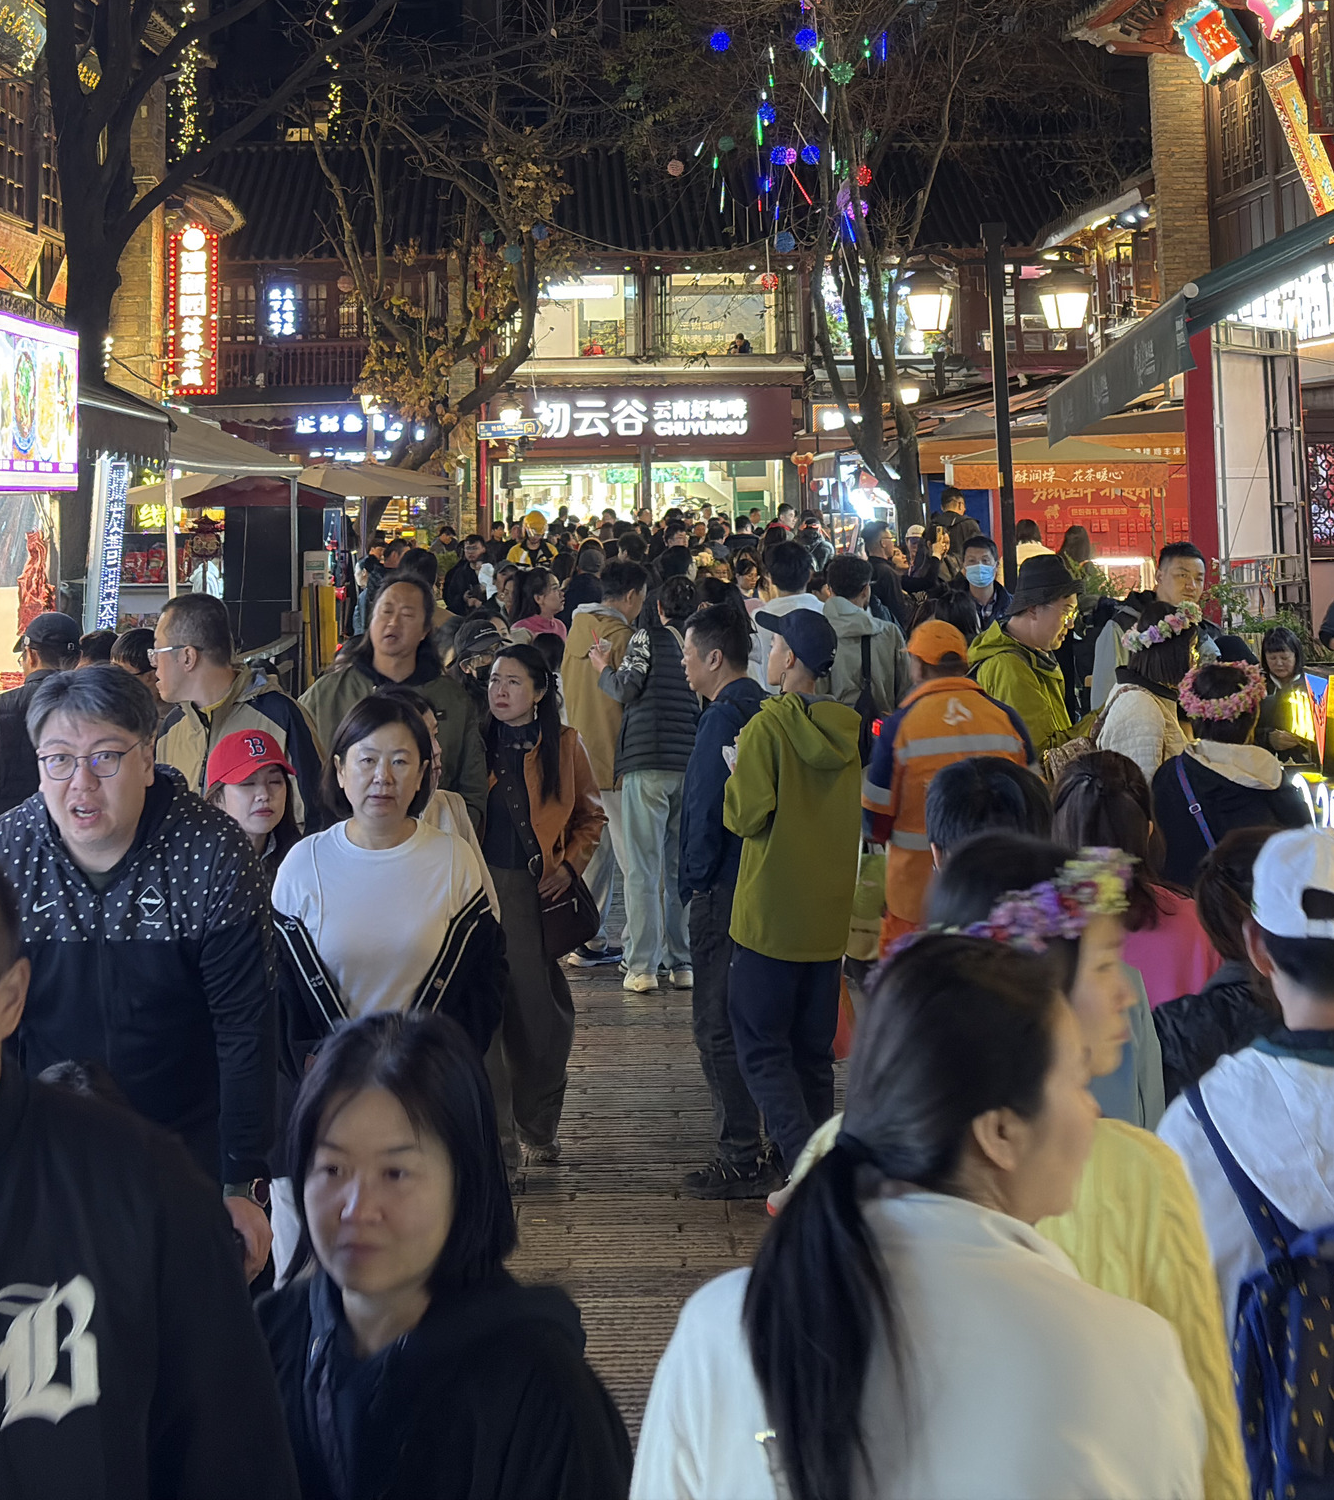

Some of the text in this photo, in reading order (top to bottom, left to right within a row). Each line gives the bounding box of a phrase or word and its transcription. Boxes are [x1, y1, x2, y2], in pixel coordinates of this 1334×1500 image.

[533, 399, 650, 439] 初云谷
[653, 398, 749, 421] 云南好咖啡
[1071, 468, 1126, 485] 花茶暖心
[244, 736, 267, 758] B
